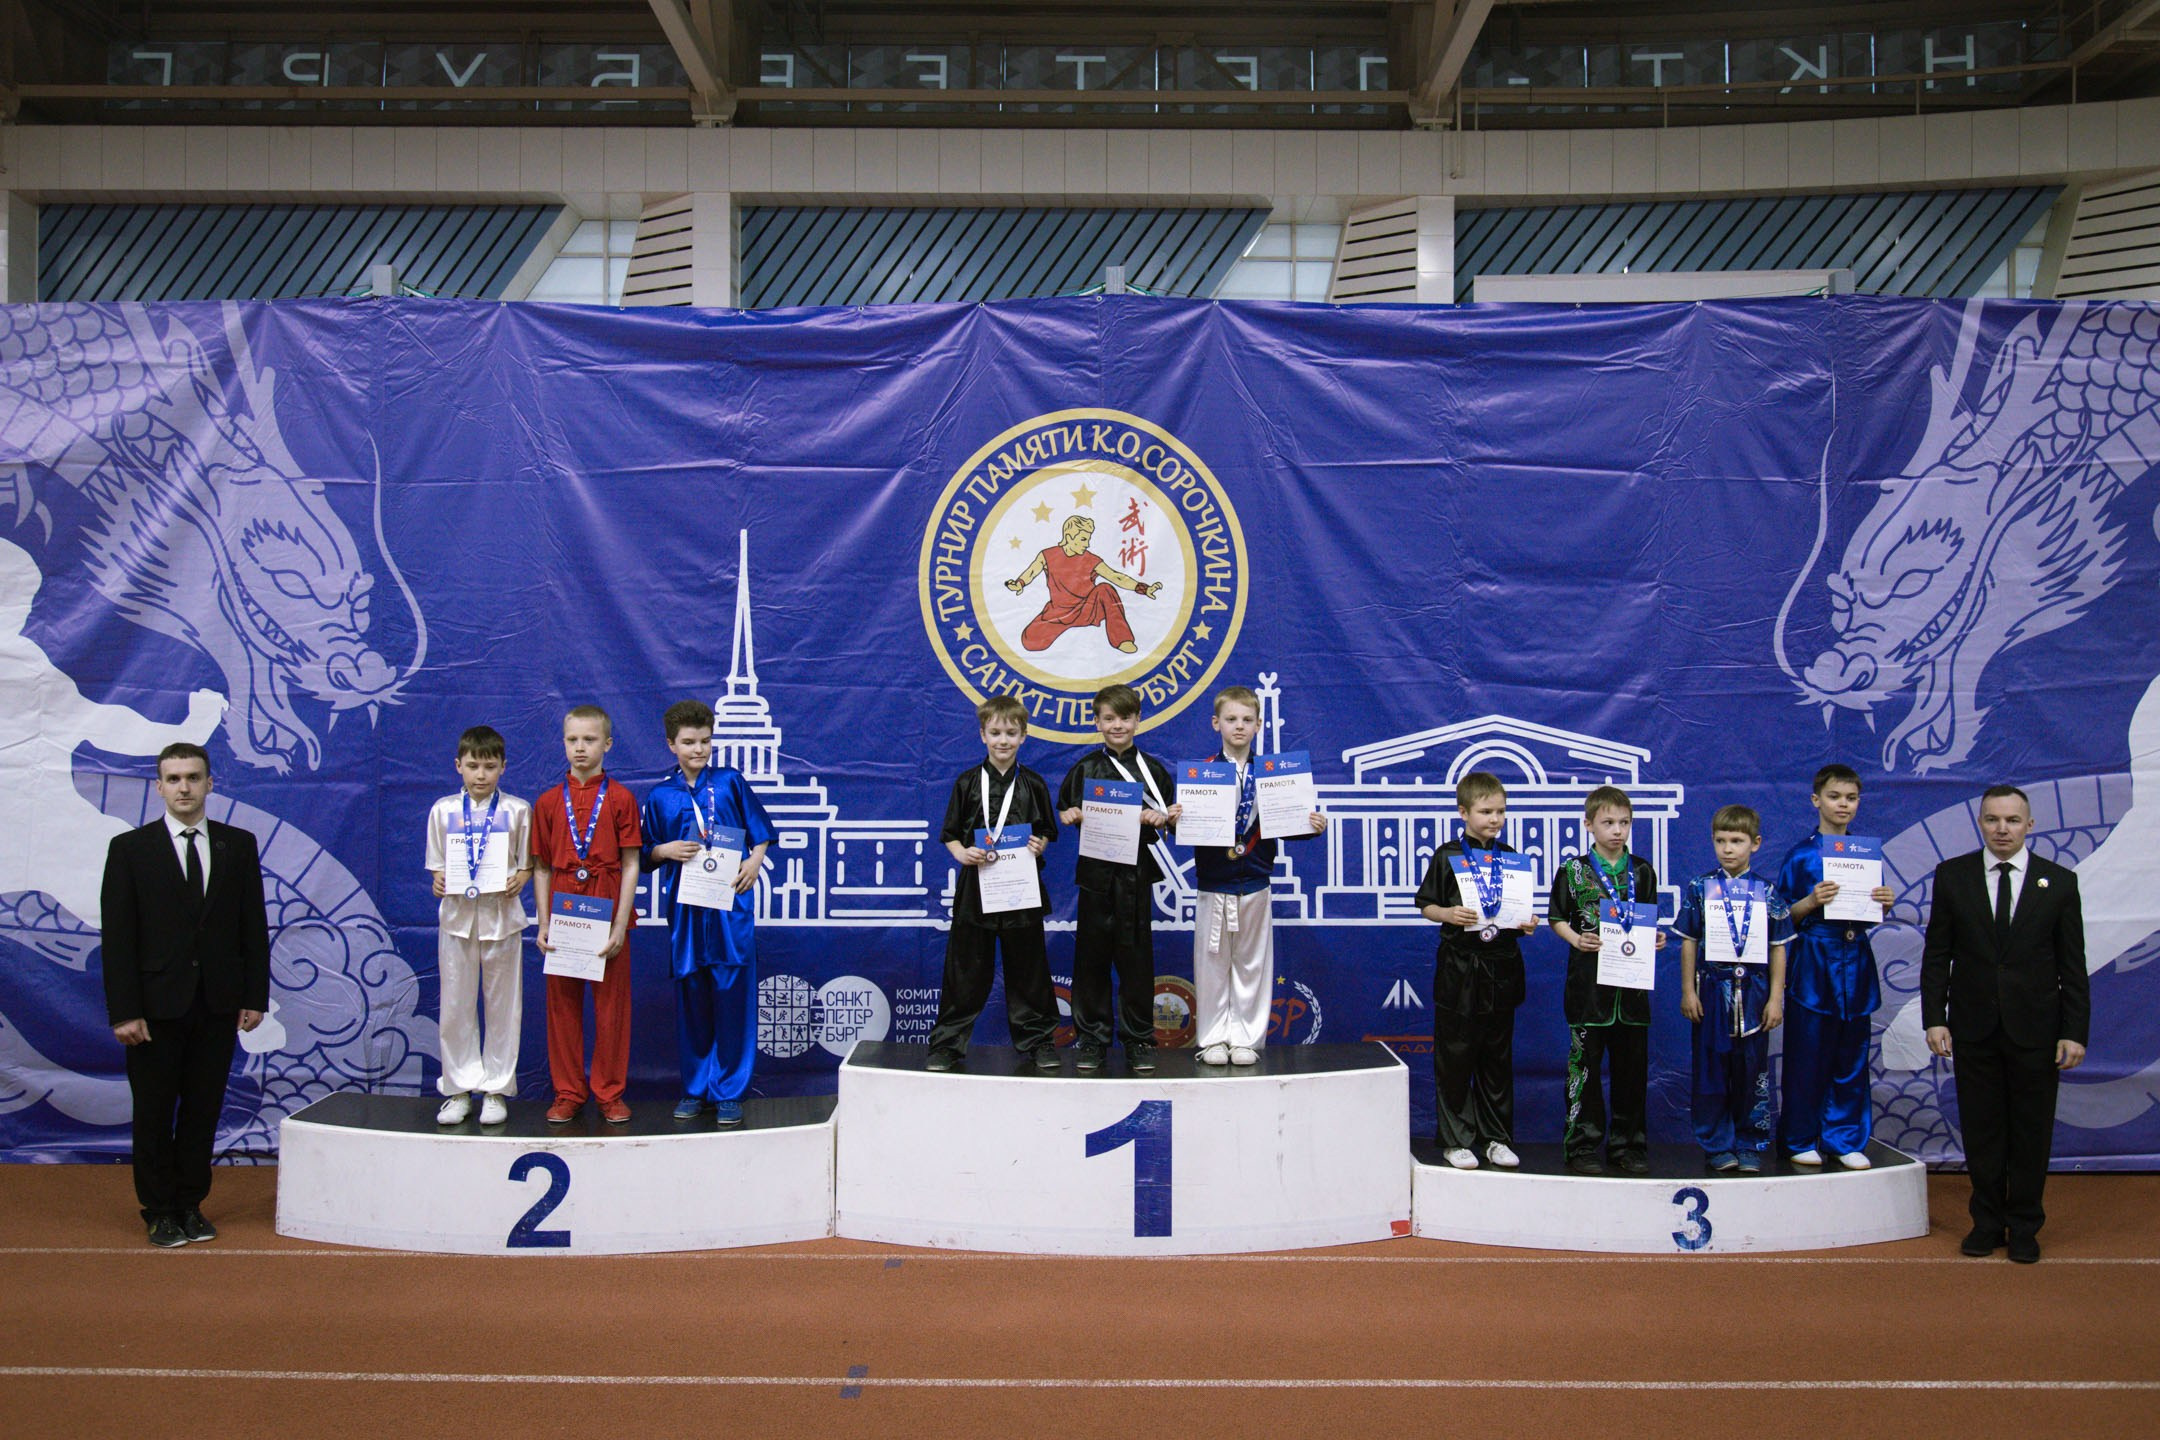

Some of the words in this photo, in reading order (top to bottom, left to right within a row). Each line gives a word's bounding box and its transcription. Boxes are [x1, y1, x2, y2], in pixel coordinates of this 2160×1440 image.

[935, 500, 976, 622] ТУРНИР
[964, 424, 1086, 505] ПАМЯТИ
[1260, 779, 1296, 789] ГРАМОТА
[1085, 805, 1123, 815] ГРАМОТА
[1828, 862, 1865, 870] ГРАМОТА
[554, 919, 592, 930] ГРАМОТА
[826, 991, 872, 1006] САНКТ
[896, 989, 942, 1000] КОМИТ
[826, 1009, 873, 1024] ПЕТЕР
[826, 1027, 864, 1042] БУРГ
[1085, 1100, 1172, 1237] 1
[506, 1152, 571, 1248] 2
[1671, 1187, 1712, 1250] 3
